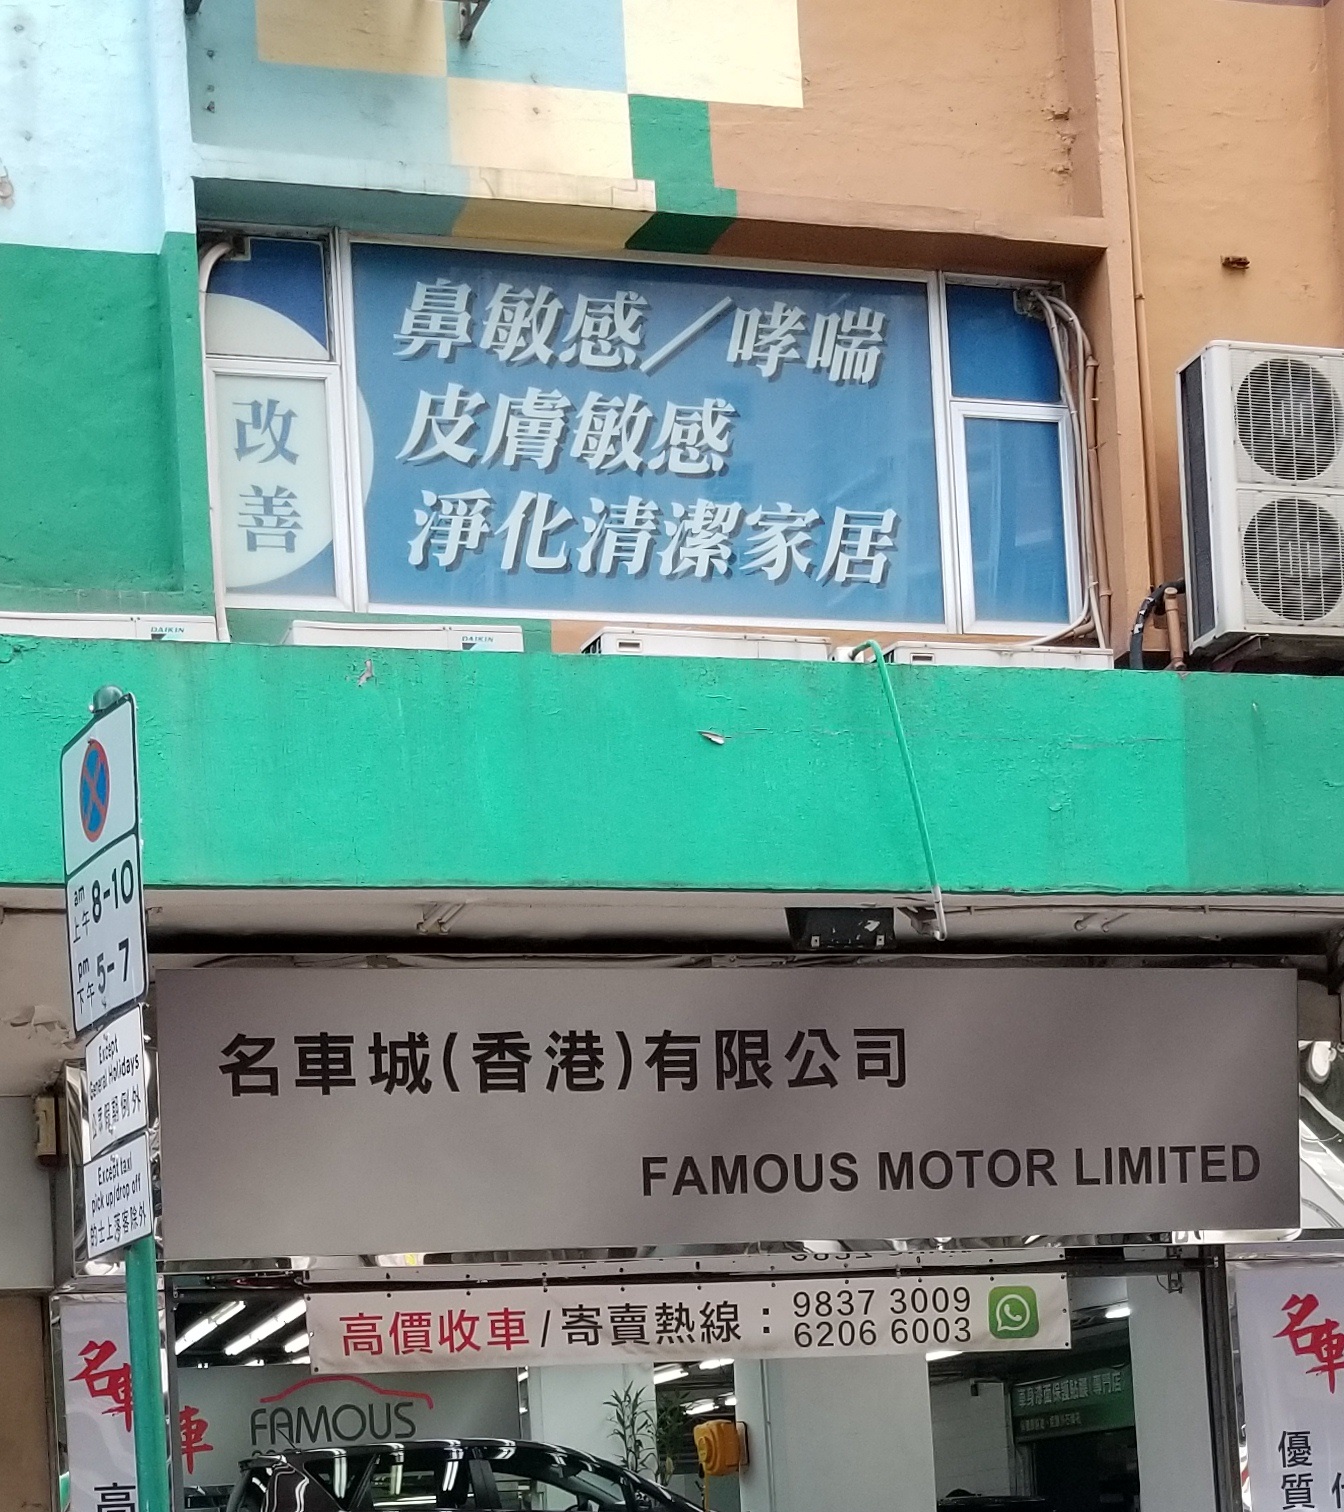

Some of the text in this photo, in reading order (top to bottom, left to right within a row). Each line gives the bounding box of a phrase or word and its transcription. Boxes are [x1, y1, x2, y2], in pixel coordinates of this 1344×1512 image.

[397, 385, 735, 477] 皮膚敏感
[233, 398, 303, 554] 改善
[408, 489, 898, 586] 淨化清潔家居
[461, 635, 495, 643] DAIKIN
[73, 859, 134, 923] am 8-10
[72, 910, 90, 943] 上午
[77, 937, 130, 994] pm 5-7
[76, 982, 95, 1014] 下午
[98, 1035, 118, 1065] Except
[89, 1053, 140, 1101] General Holidays
[97, 1157, 120, 1186] Except
[641, 1144, 1261, 1197] FAMOUS MOTOR LIMITED
[792, 1287, 973, 1319] 9837 3009
[793, 1316, 973, 1348] 6206 6003
[250, 1401, 417, 1446] FAMOUS
